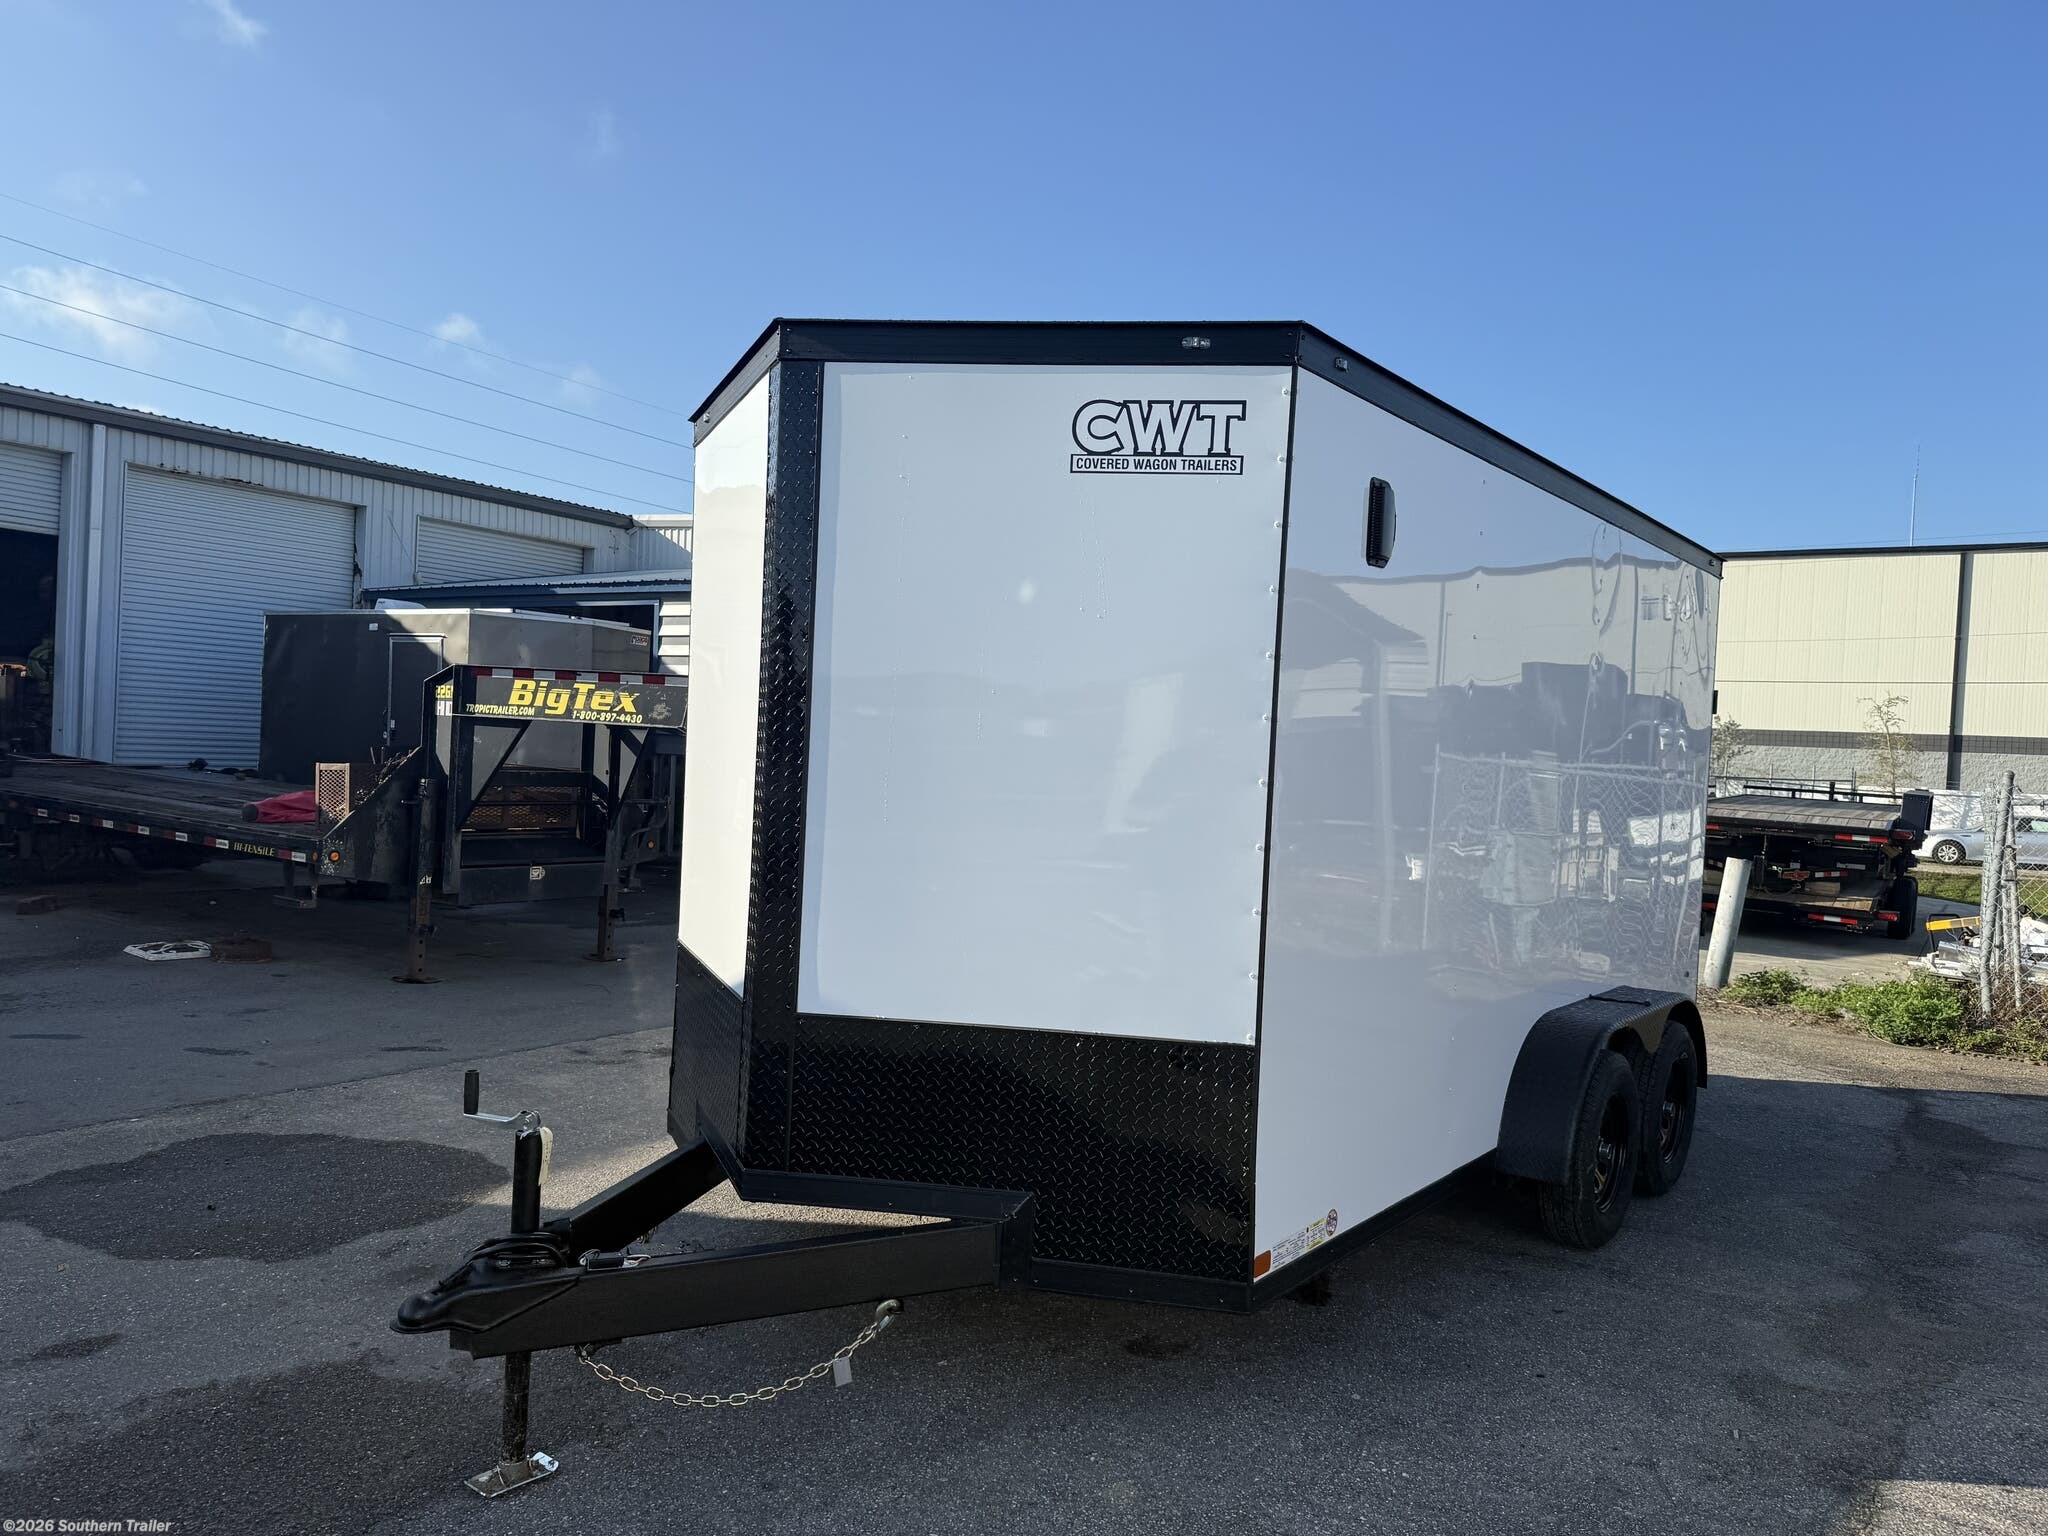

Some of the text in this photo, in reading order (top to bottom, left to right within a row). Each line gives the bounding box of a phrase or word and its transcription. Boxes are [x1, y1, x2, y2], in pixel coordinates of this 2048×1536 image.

[1072, 399, 1246, 455] CWT
[1076, 457, 1237, 472] COVERED WAGON TRAILERS
[466, 703, 535, 716] TROPICTRAILER.COM
[572, 710, 643, 723] 1-800-897-4430
